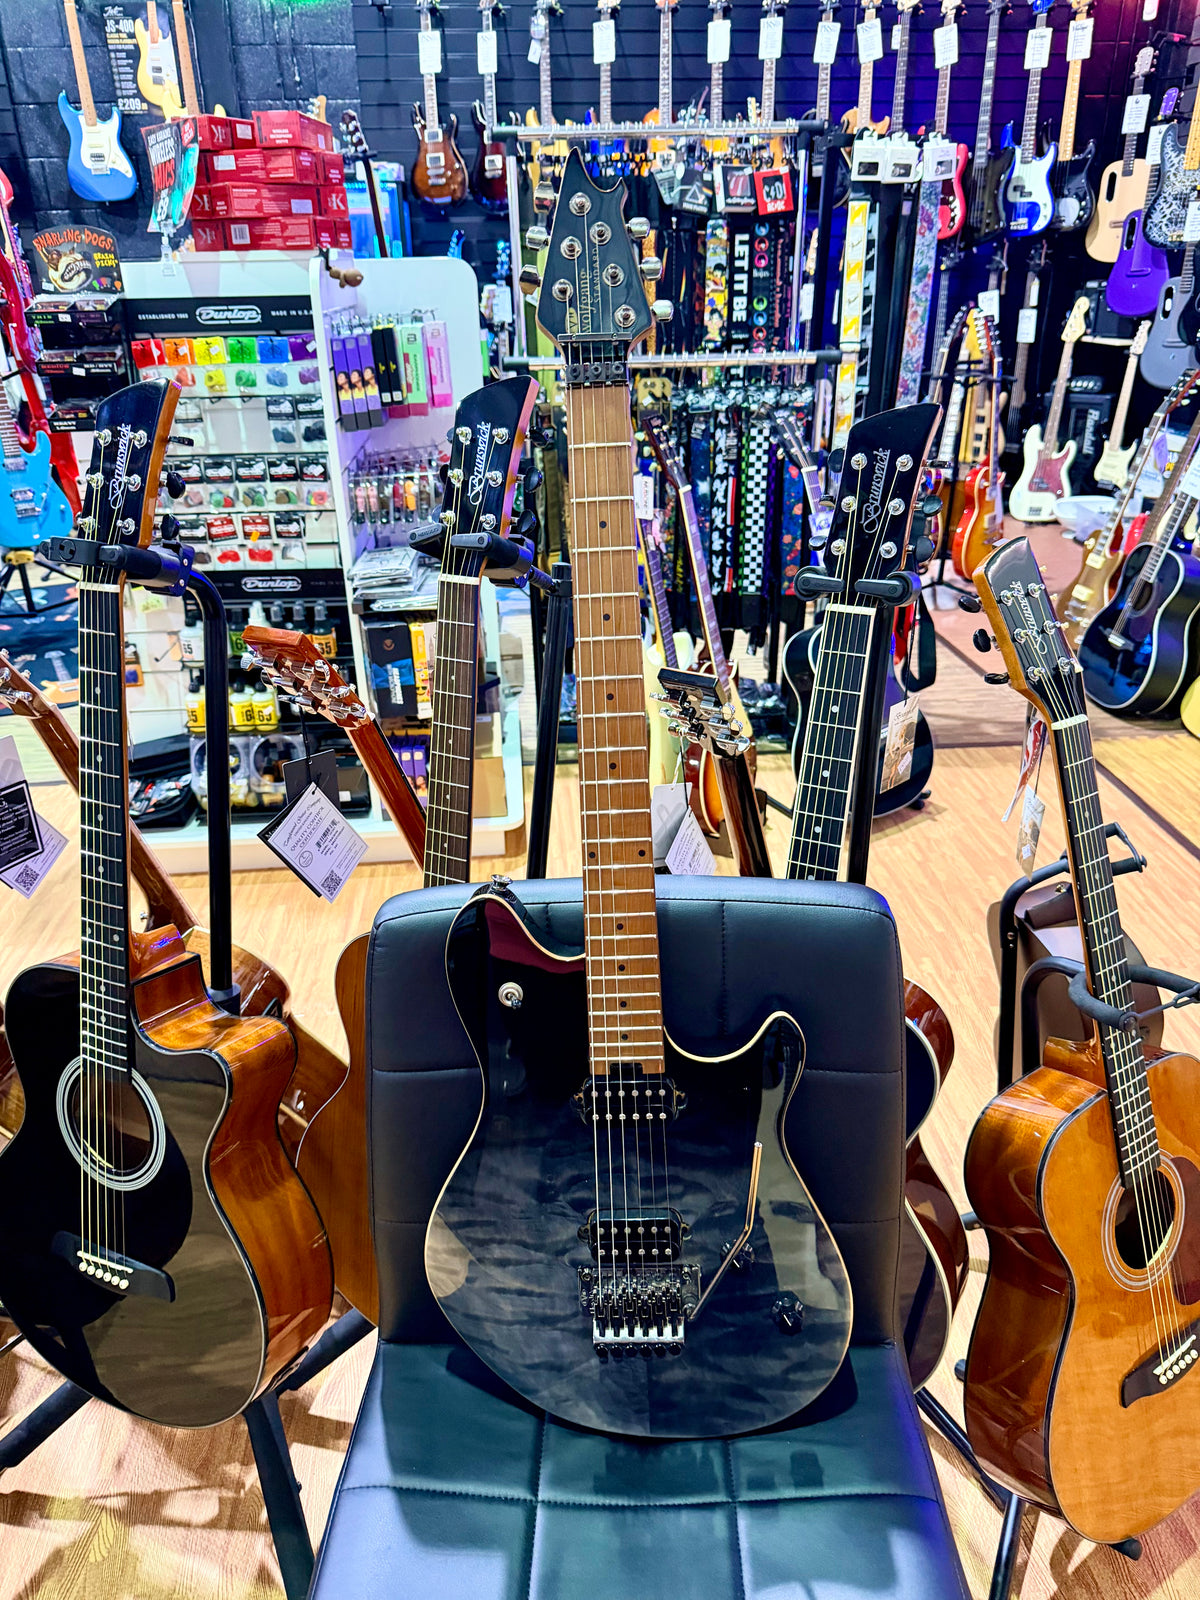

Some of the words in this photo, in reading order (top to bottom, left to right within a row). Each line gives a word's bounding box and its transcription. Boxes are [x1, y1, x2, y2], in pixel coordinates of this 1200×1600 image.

[105, 19, 134, 33] JS-400
[118, 98, 141, 111] £209
[148, 138, 175, 167] WIRELESS
[153, 158, 175, 193] MICS
[32, 229, 81, 252] SNARLING
[84, 227, 113, 251] DOGS
[734, 233, 750, 272] LET
[592, 247, 600, 303] STANDARD
[733, 273, 749, 295] IT
[138, 313, 175, 321] ESTABLISHED
[199, 308, 259, 322] Dunlop
[732, 295, 747, 323] BE
[1082, 408, 1100, 455] Randall
[109, 423, 131, 509] Brunswick
[467, 421, 491, 506] Brunswick
[860, 447, 891, 534] Brunswick
[243, 577, 300, 591] Dunlop
[1010, 580, 1048, 655] Brunswick
[290, 827, 309, 852] QUALITY
[307, 806, 324, 830] CONTROL
[299, 815, 324, 849] CERTIFICATE
